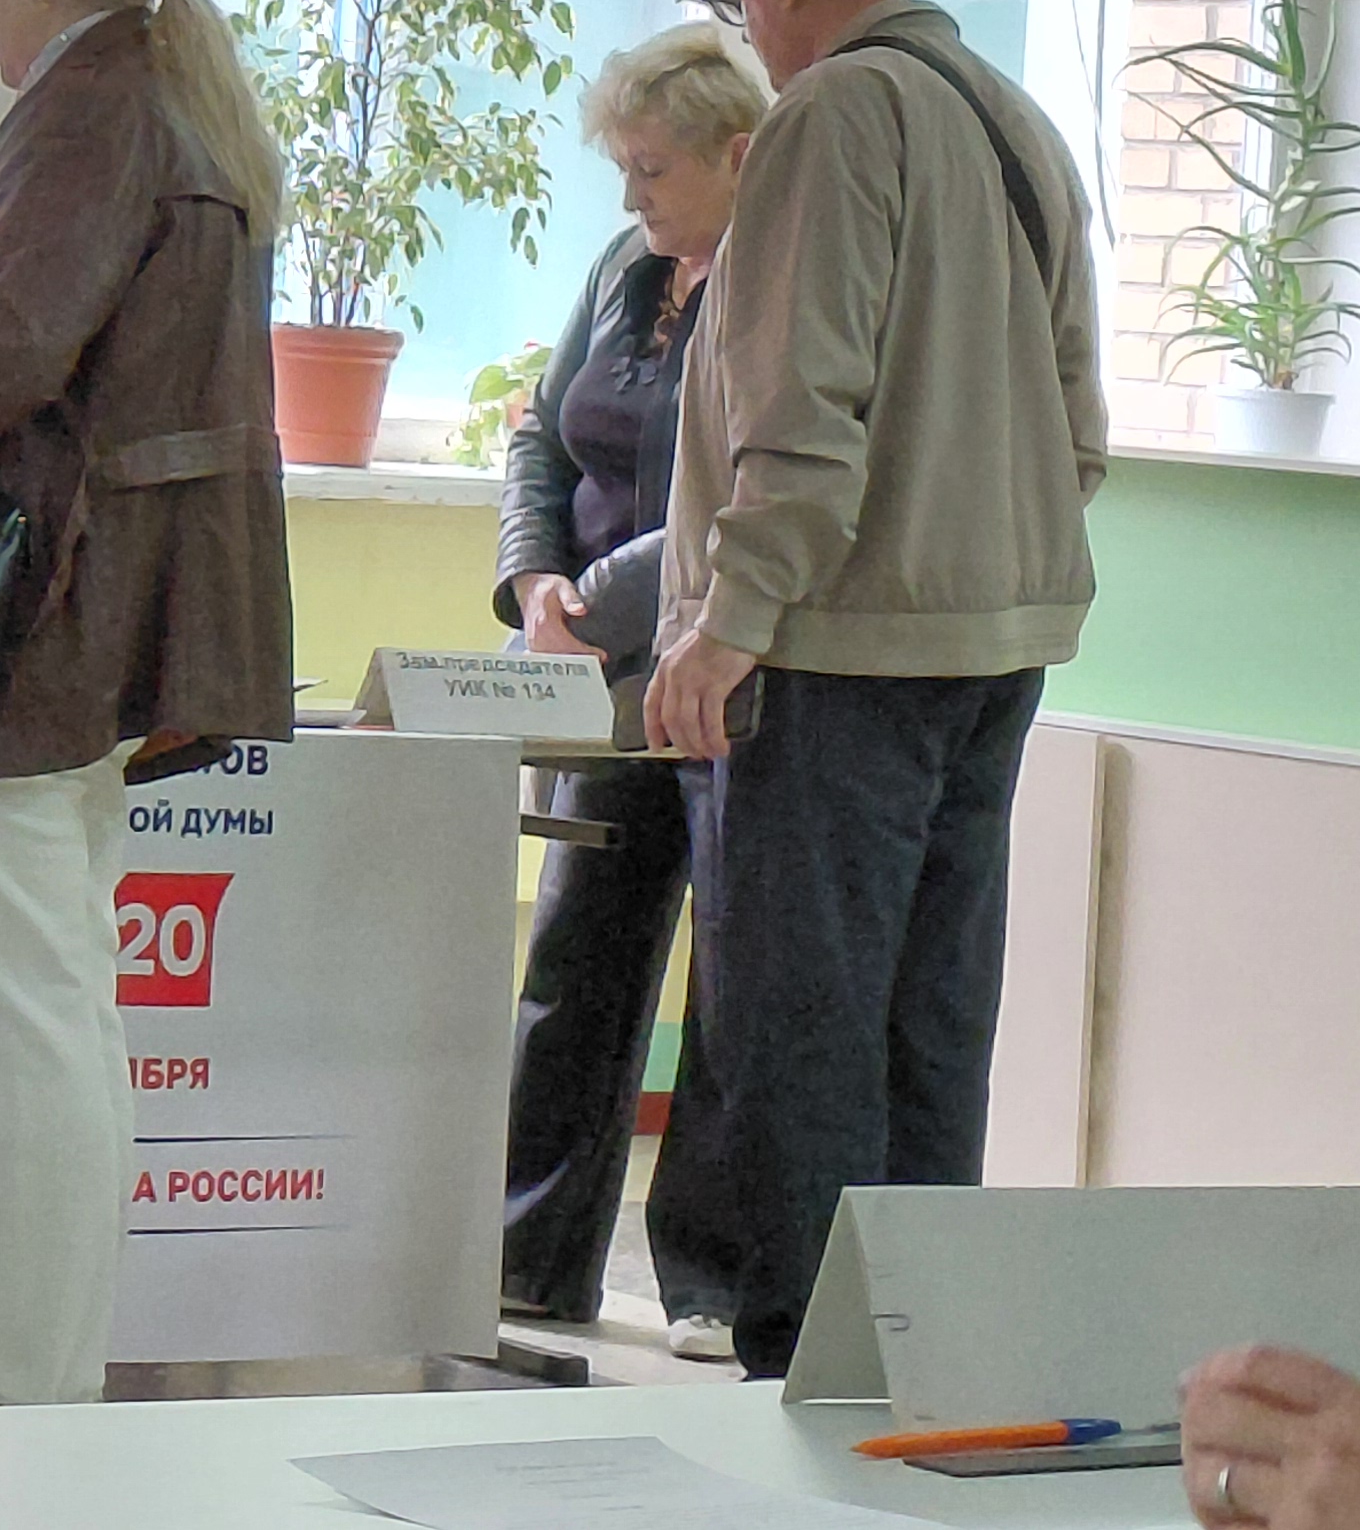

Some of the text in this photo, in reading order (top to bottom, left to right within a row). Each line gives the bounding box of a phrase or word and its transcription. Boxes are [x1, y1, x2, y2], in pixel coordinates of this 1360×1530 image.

[202, 744, 269, 776] ОВ
[128, 798, 173, 833] ОЙ
[180, 808, 274, 839] ДУМЫ
[116, 902, 206, 977] 20
[128, 1056, 210, 1090] БРЯ
[131, 1171, 158, 1203] А
[167, 1168, 325, 1203] РОССИИ!
